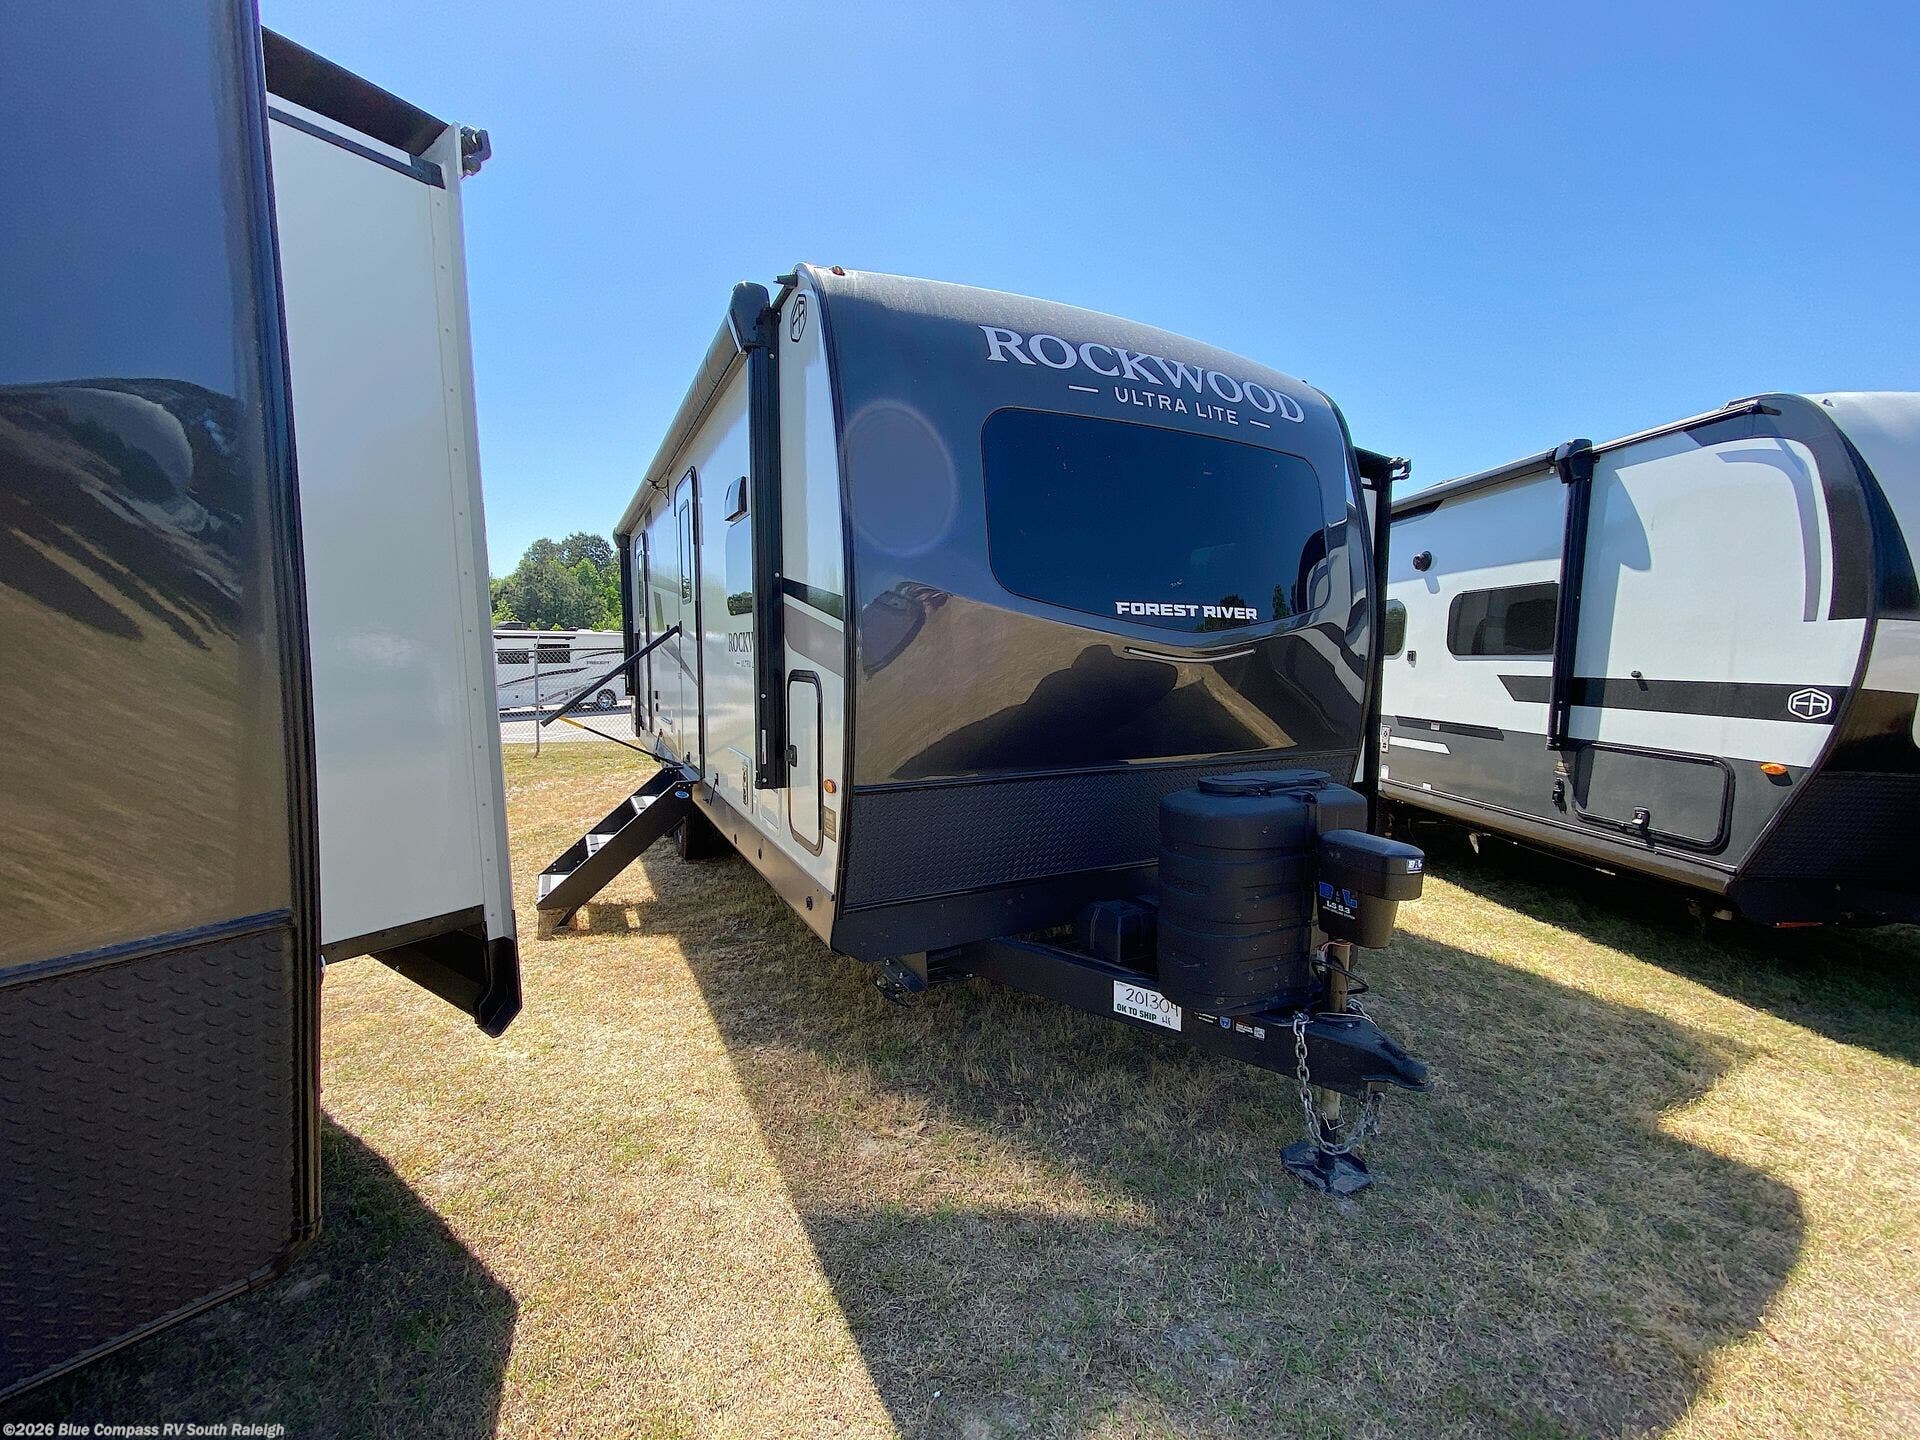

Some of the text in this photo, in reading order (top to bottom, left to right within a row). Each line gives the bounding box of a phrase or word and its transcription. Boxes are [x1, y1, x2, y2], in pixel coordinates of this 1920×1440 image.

[978, 324, 1305, 424] ROCKWOOD
[1114, 386, 1239, 425] ULTRA LITE
[1115, 601, 1258, 620] FOREST RIVER
[1116, 1003, 1127, 1013] OK
[1129, 1006, 1138, 1016] TO
[1139, 1010, 1157, 1022] SHIP
